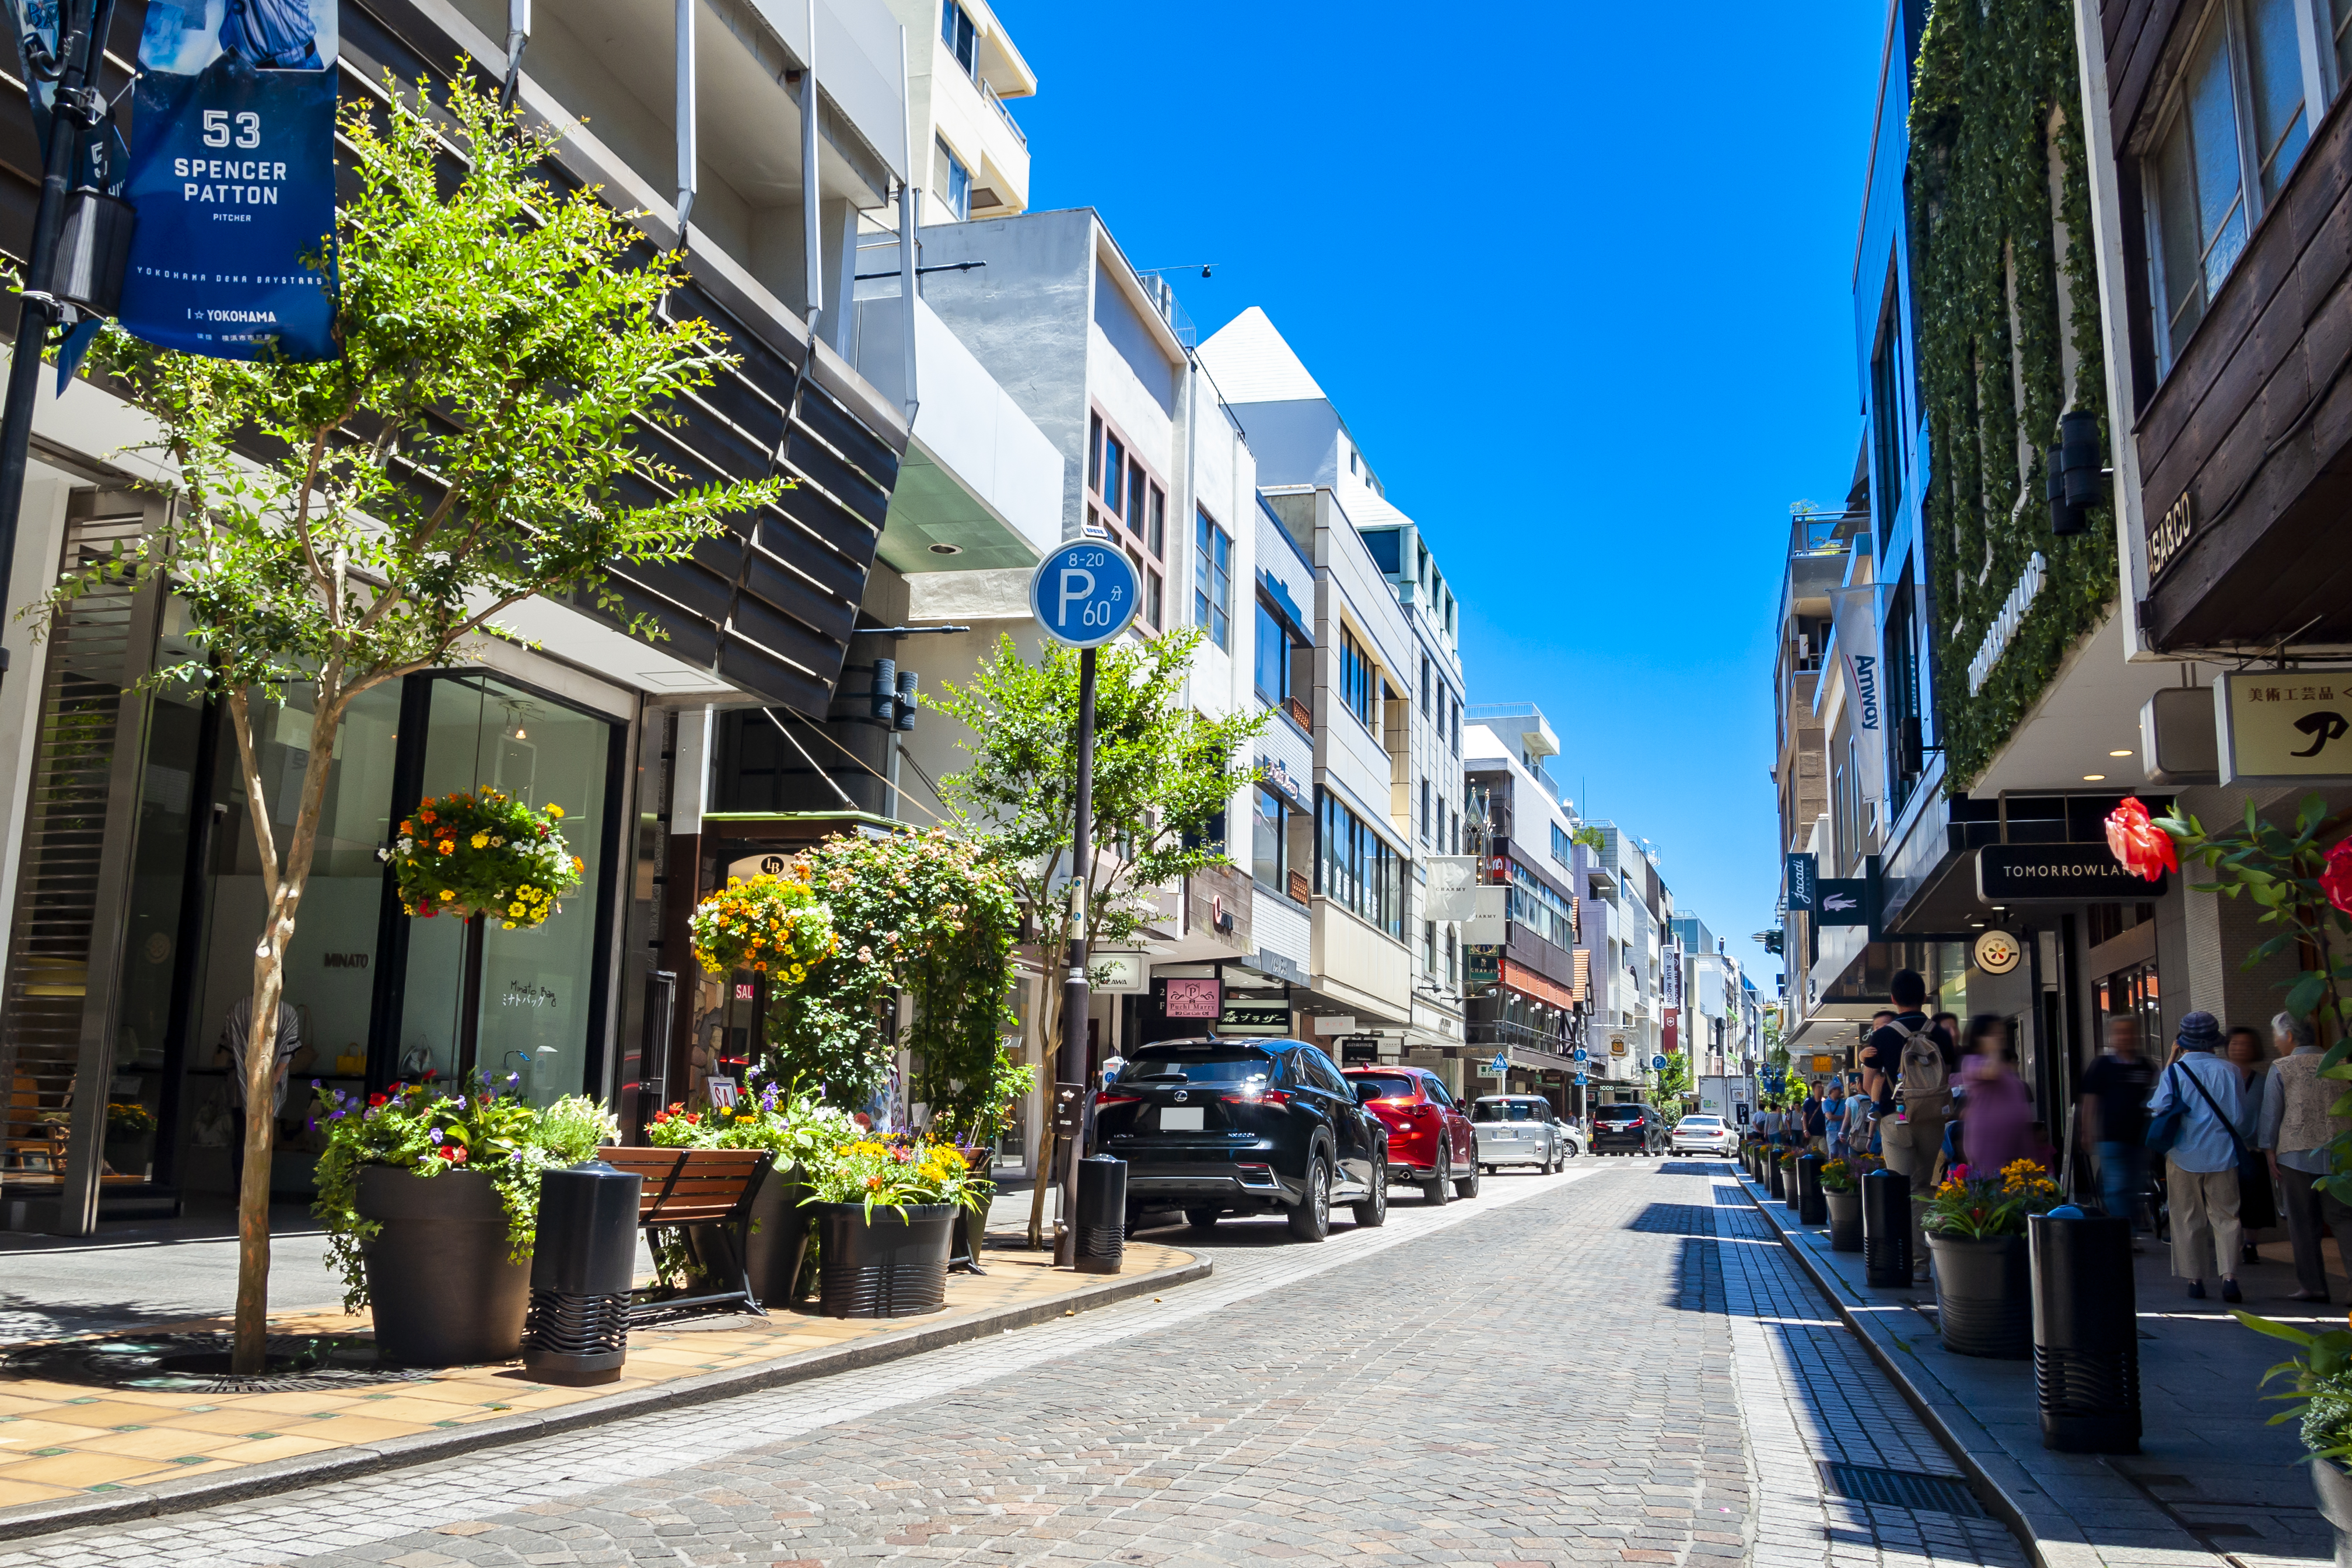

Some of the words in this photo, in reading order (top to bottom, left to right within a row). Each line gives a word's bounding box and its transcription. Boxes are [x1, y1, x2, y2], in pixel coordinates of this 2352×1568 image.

[203, 109, 260, 148] 53
[174, 158, 286, 180] SPENCER
[184, 183, 278, 204] PATTON
[213, 213, 251, 222] PITCHER
[137, 266, 206, 281] YOKOHAMA
[257, 276, 322, 285] BAYSTARS
[187, 308, 191, 319] I
[206, 309, 277, 323] YOKOHAMA
[1068, 552, 1104, 567] 8-20
[1058, 568, 1096, 626] P
[1083, 600, 1111, 626] 60
[1110, 585, 1123, 601] 分
[1968, 551, 2047, 698] TOMORROWLAND
[1854, 654, 1879, 730] Amway
[2248, 686, 2334, 702] 美術工芸品
[766, 858, 780, 874] LB
[2003, 864, 2132, 877] TOMORROWLA
[1322, 858, 1377, 920] 高倉歯科医院
[1791, 859, 1811, 904] jacadi
[324, 953, 369, 968] MINATO
[510, 979, 537, 995] Minato
[502, 993, 546, 1008] ミナトバッグ
[1222, 1010, 1286, 1023] 森ブラザー
[1740, 1107, 1746, 1115] P
